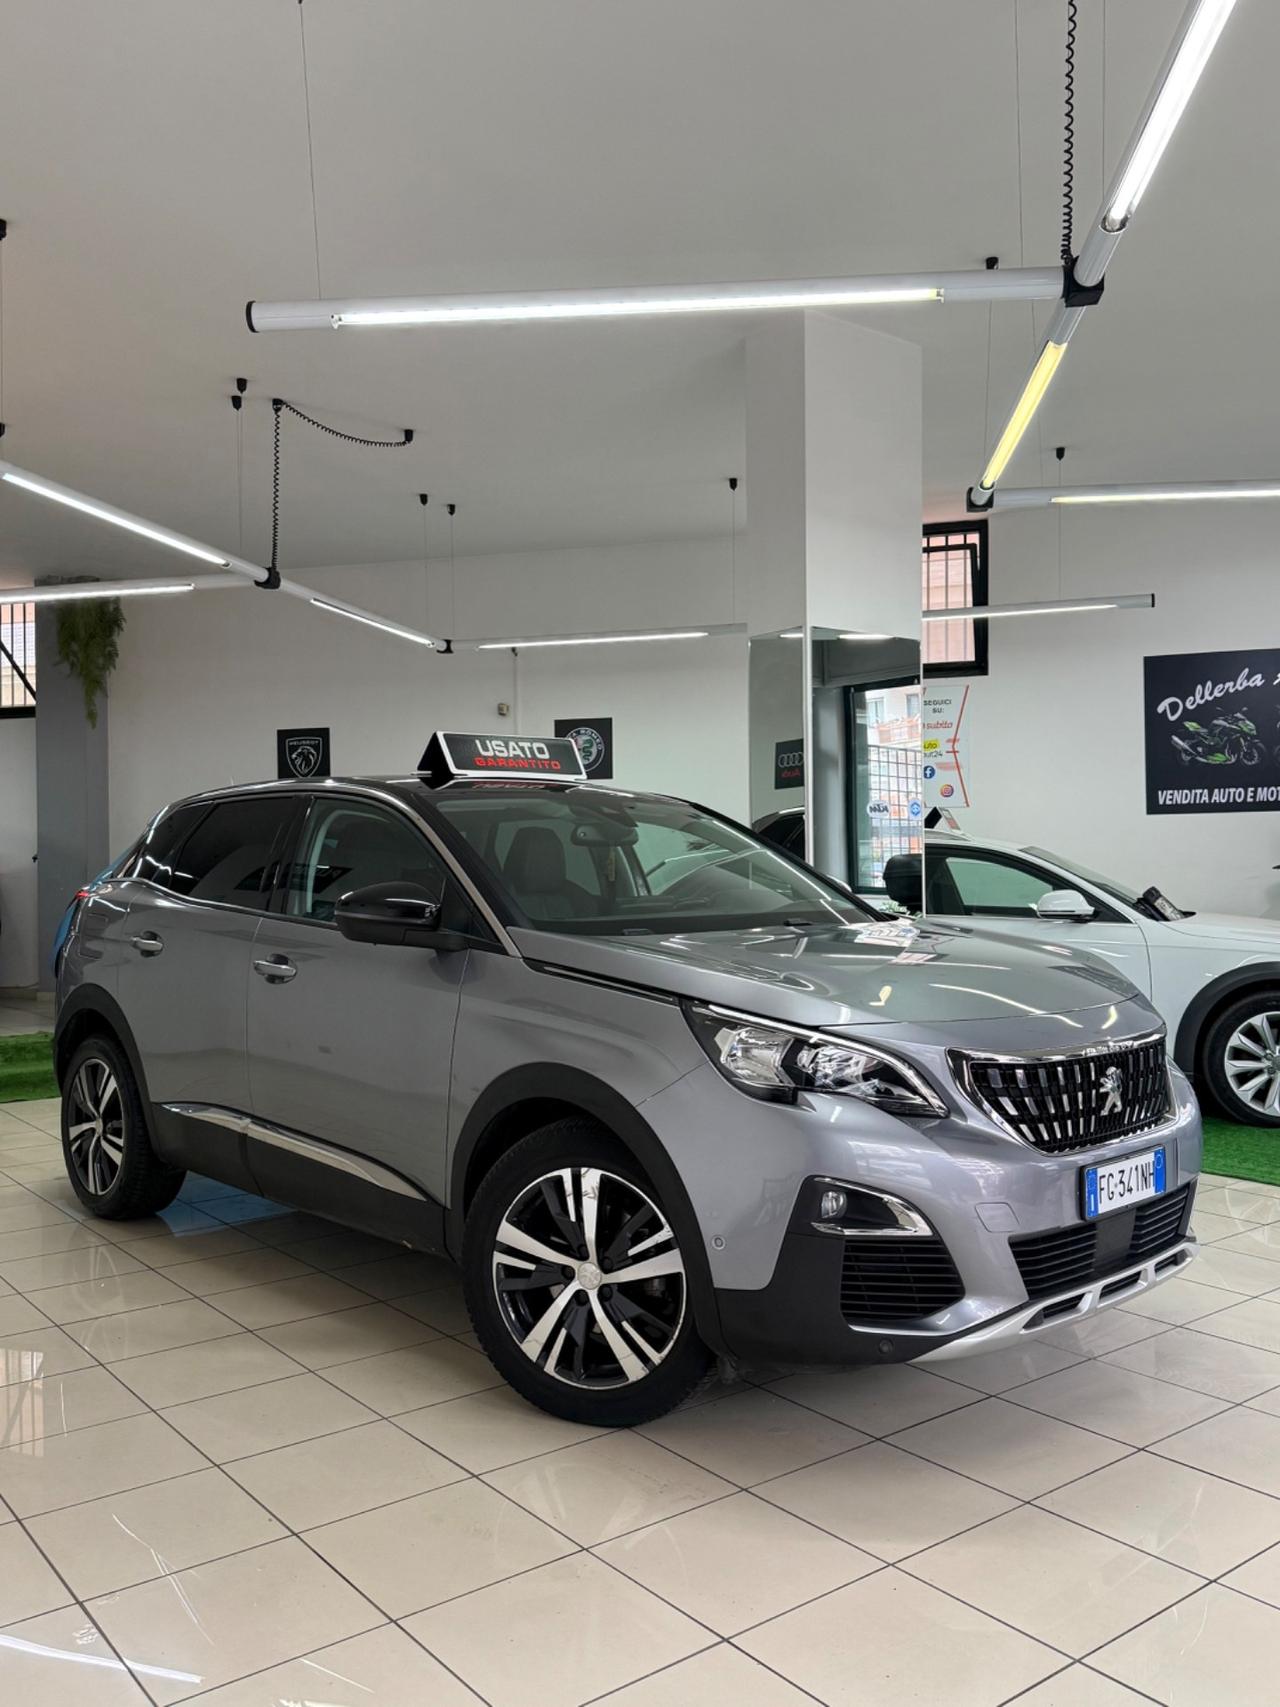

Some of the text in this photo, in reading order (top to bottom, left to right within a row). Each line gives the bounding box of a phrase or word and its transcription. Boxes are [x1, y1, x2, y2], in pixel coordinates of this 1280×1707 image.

[1157, 667, 1265, 721] Dellerba
[475, 739, 550, 759] USATO
[473, 756, 561, 771] GARANTITO
[1158, 789, 1209, 805] VENDITA
[1211, 787, 1244, 803] AUTO
[1247, 787, 1255, 802] E
